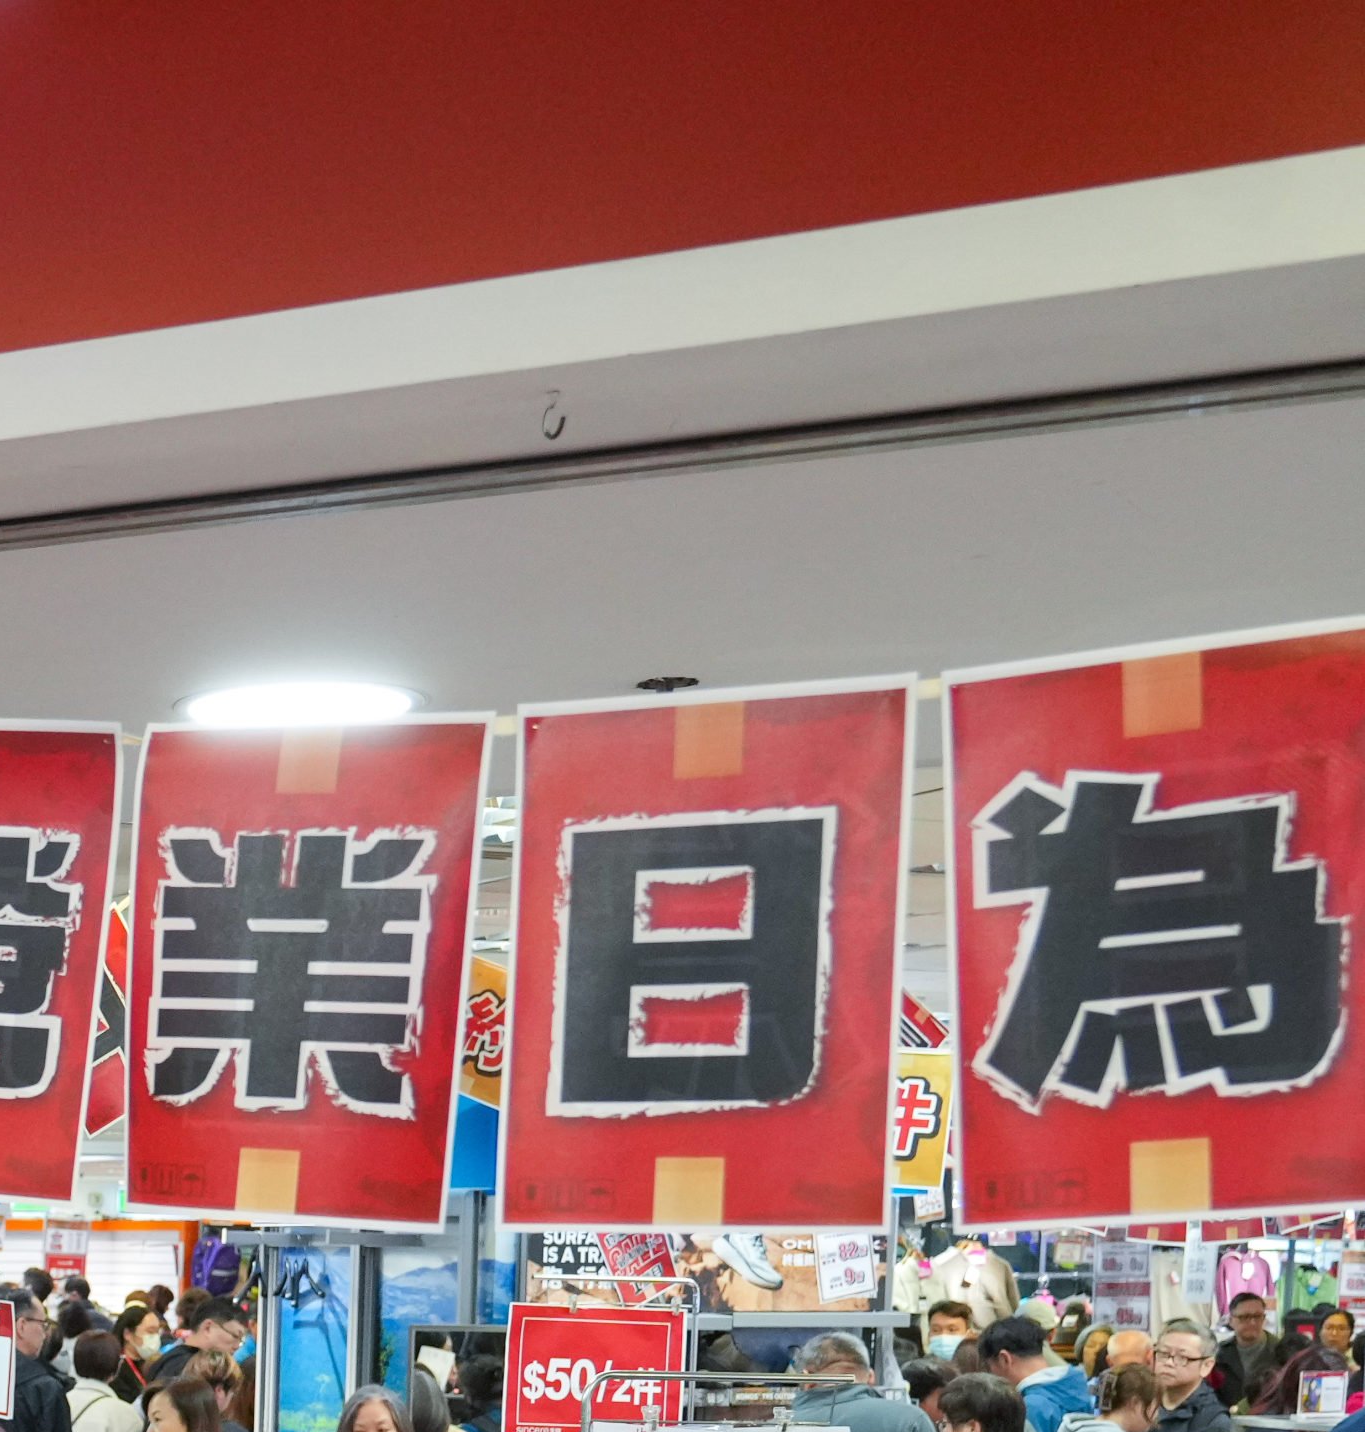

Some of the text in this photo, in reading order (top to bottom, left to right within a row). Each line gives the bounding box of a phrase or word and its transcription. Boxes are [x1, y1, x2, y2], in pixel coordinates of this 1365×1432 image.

[542, 1246, 605, 1264] IS A TR
